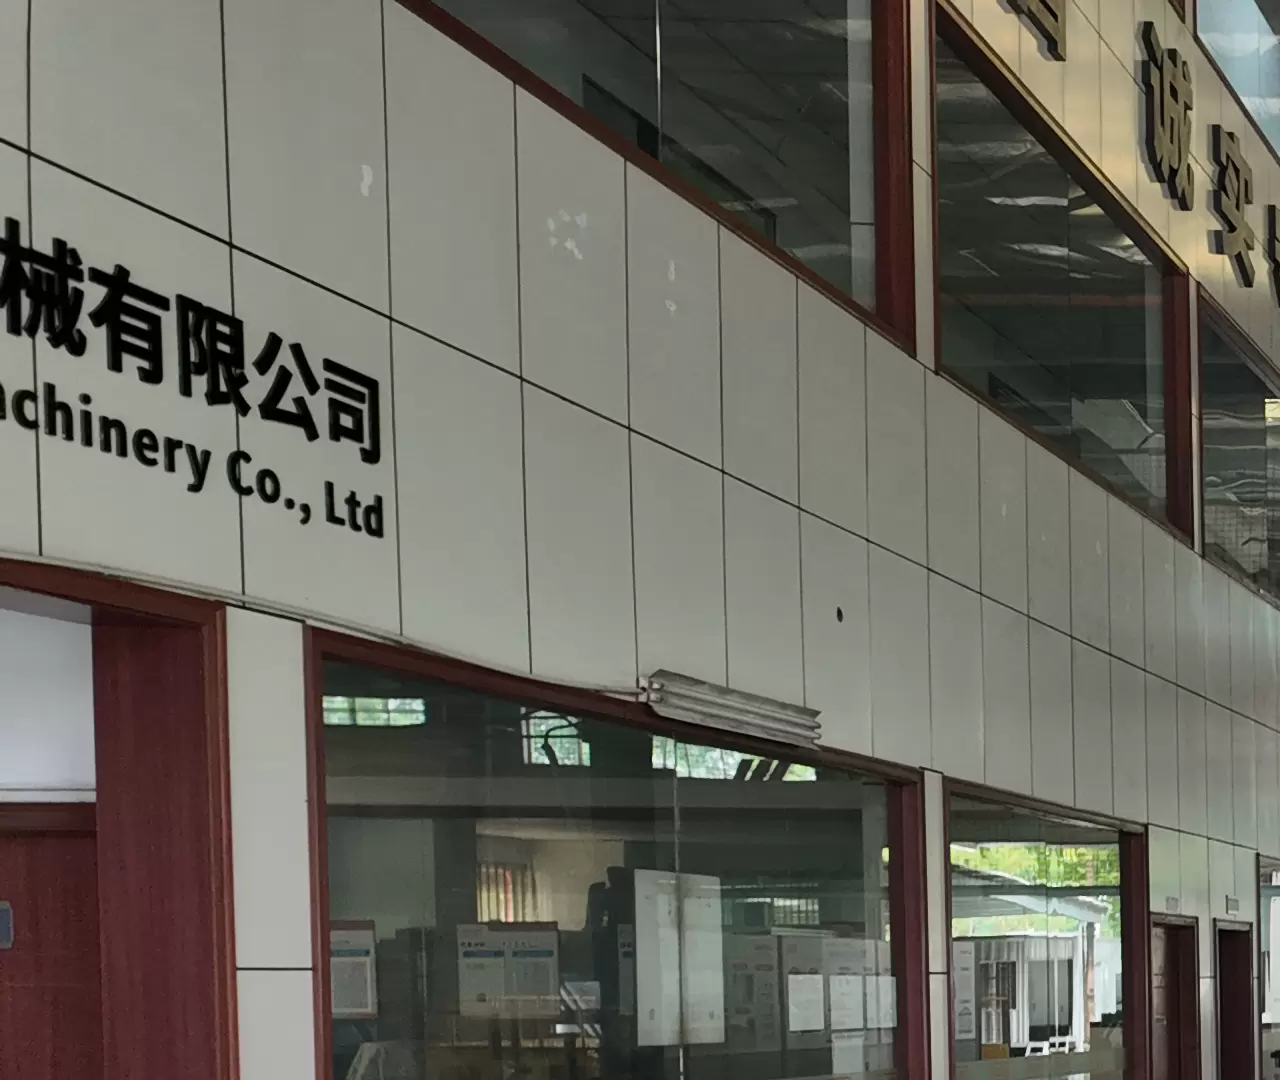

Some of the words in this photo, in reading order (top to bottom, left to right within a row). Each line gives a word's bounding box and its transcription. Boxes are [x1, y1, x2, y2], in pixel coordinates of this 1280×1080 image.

[0, 216, 381, 465] 械有限公司
[0, 368, 211, 493] chinery
[226, 450, 311, 524] Co.,
[323, 480, 384, 538] Ltd
